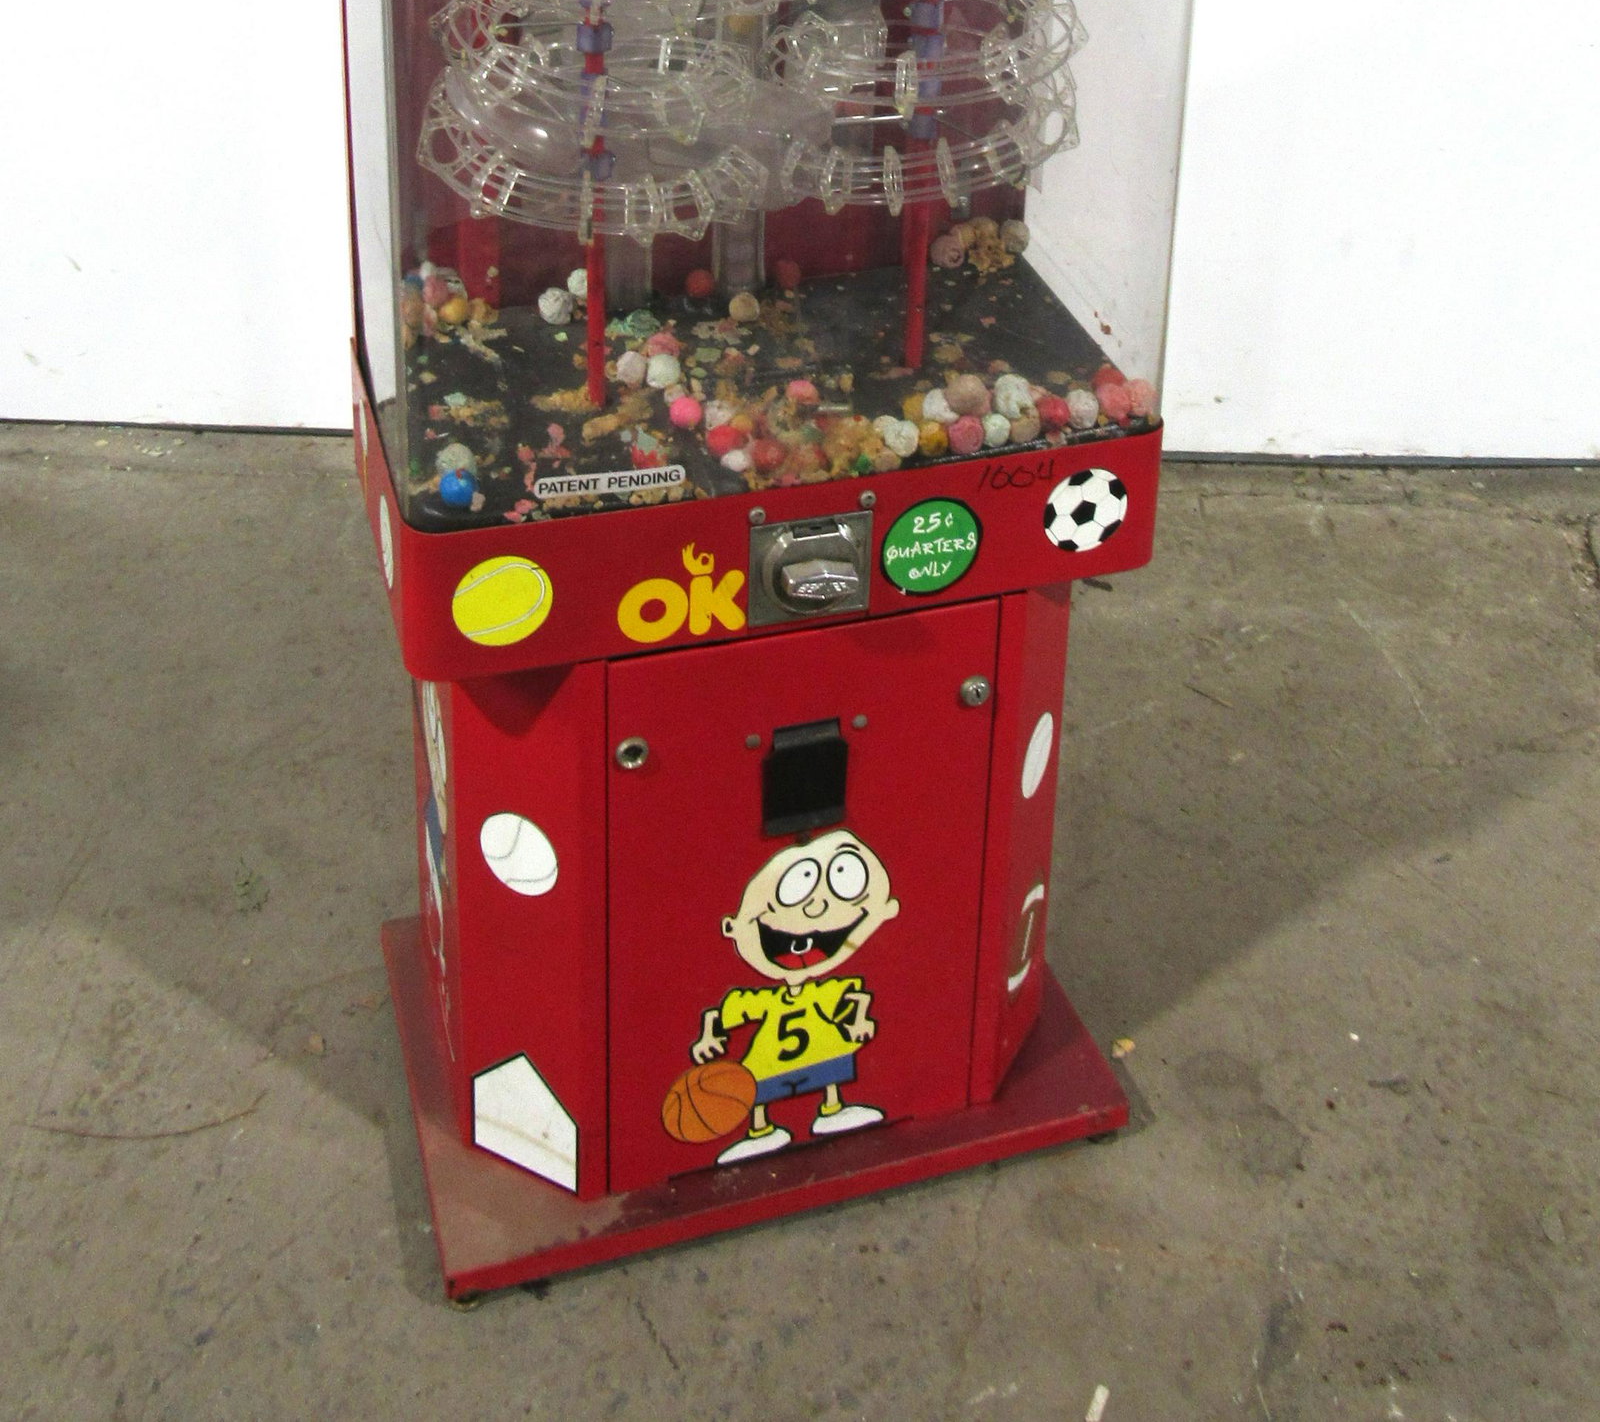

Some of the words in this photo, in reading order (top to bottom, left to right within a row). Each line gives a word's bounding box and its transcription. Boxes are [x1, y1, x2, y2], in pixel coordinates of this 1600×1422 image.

[538, 479, 600, 494] PATENT
[607, 469, 681, 489] PENDING
[886, 531, 978, 566] QUARTERS
[908, 560, 952, 579] ONLY
[617, 569, 746, 644] OK
[777, 1008, 810, 1062] 5
